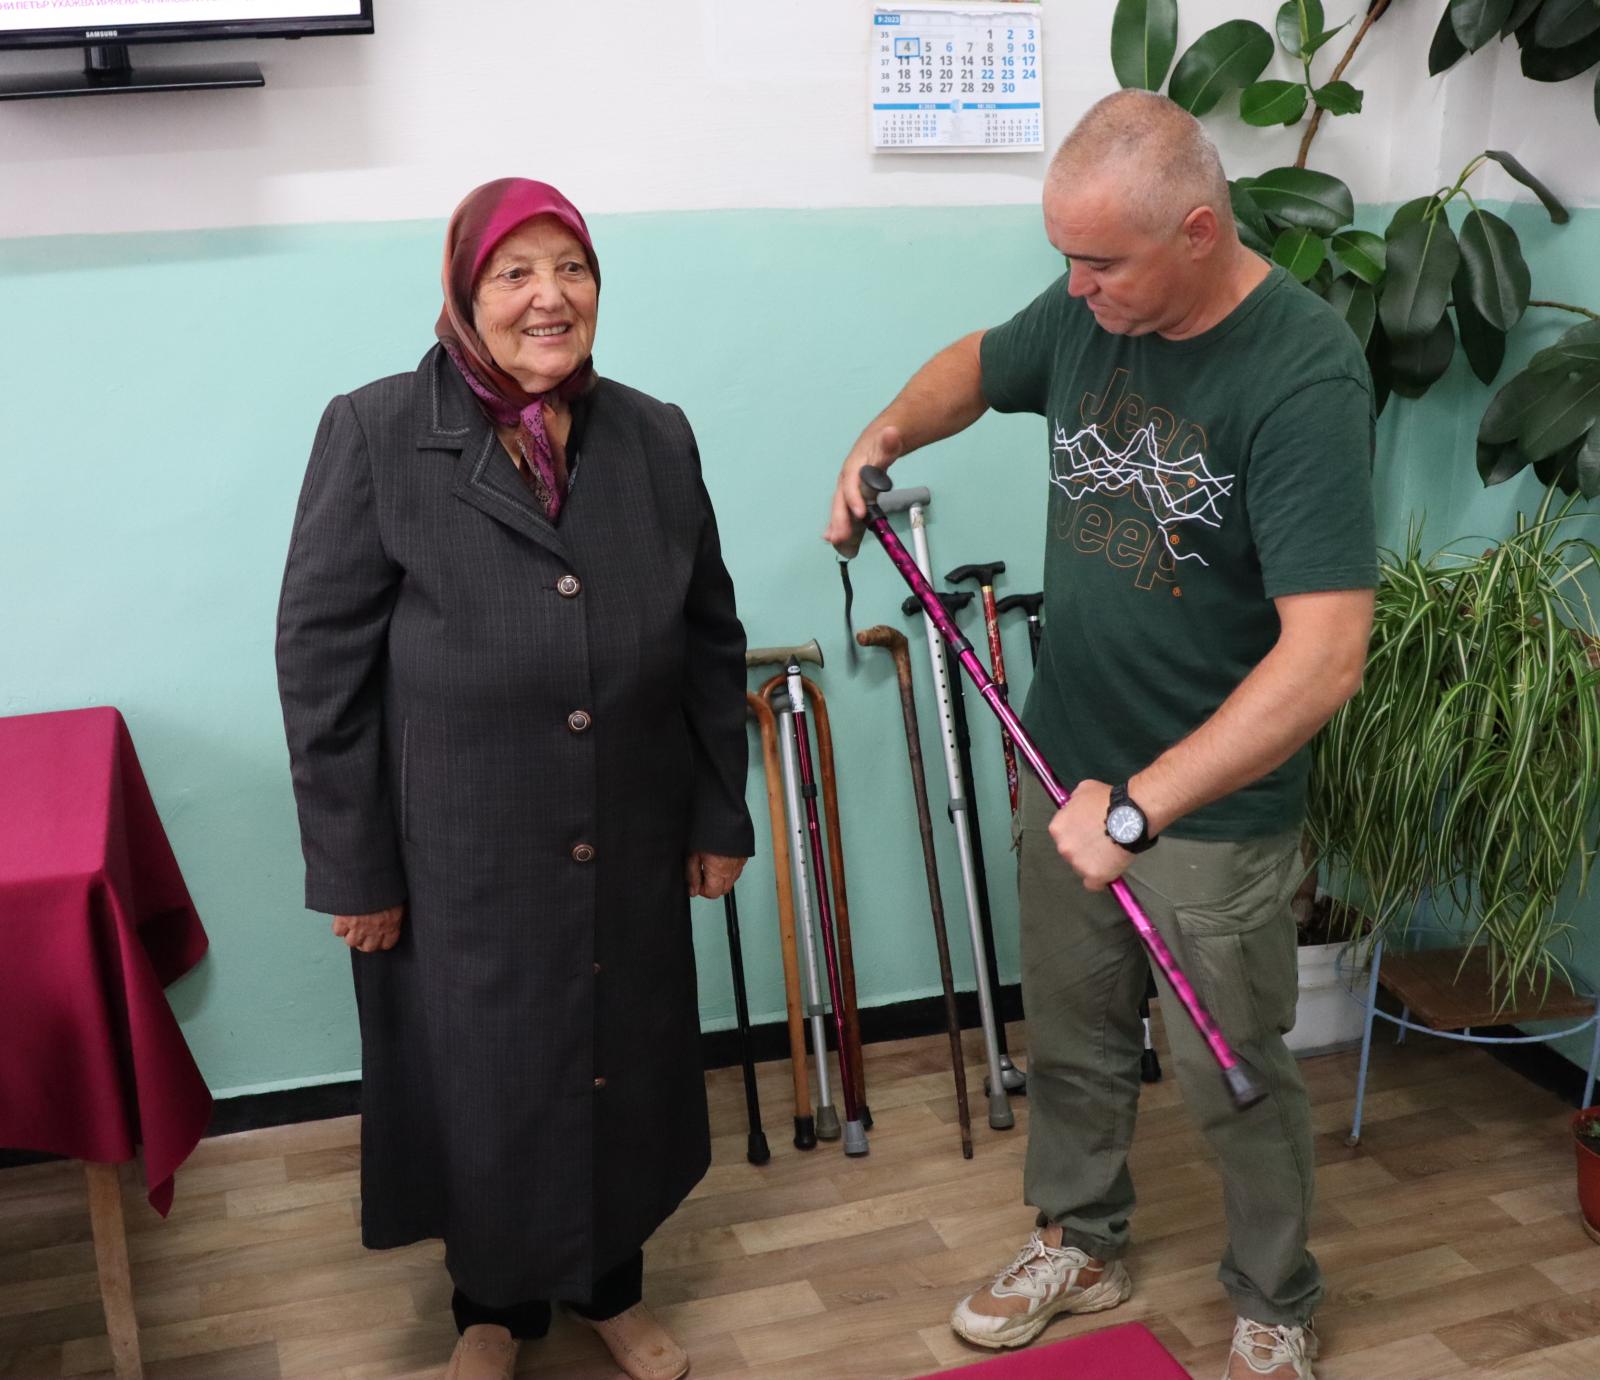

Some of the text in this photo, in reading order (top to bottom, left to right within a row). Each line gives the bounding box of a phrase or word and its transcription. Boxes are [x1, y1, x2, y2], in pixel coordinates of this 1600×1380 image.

[988, 30, 992, 39] 1
[1008, 30, 1013, 39] 2
[1029, 30, 1034, 39] 3
[904, 42, 911, 51] 4
[926, 42, 931, 52] 5
[946, 42, 952, 52] 6
[967, 42, 973, 52] 7
[987, 43, 993, 53] 8
[1008, 43, 1014, 53] 9
[1022, 43, 1035, 53] 10
[898, 56, 911, 65] 11
[919, 56, 931, 65] 12
[940, 56, 952, 65] 13
[961, 56, 973, 65] 14
[982, 56, 993, 66] 15
[1002, 56, 1014, 66] 16
[1023, 56, 1035, 65] 17
[898, 69, 911, 79] 18
[920, 69, 932, 79] 19
[940, 69, 952, 79] 20
[961, 69, 973, 79] 21
[982, 70, 993, 79] 22
[1002, 70, 1014, 79] 23
[1023, 70, 1036, 79] 24
[898, 83, 911, 93] 25
[919, 83, 932, 92] 26
[940, 83, 953, 92] 27
[962, 83, 974, 92] 28
[982, 83, 994, 92] 29
[1002, 83, 1015, 92] 30
[1081, 368, 1207, 482] Jeep
[1056, 480, 1176, 590] Jeep
